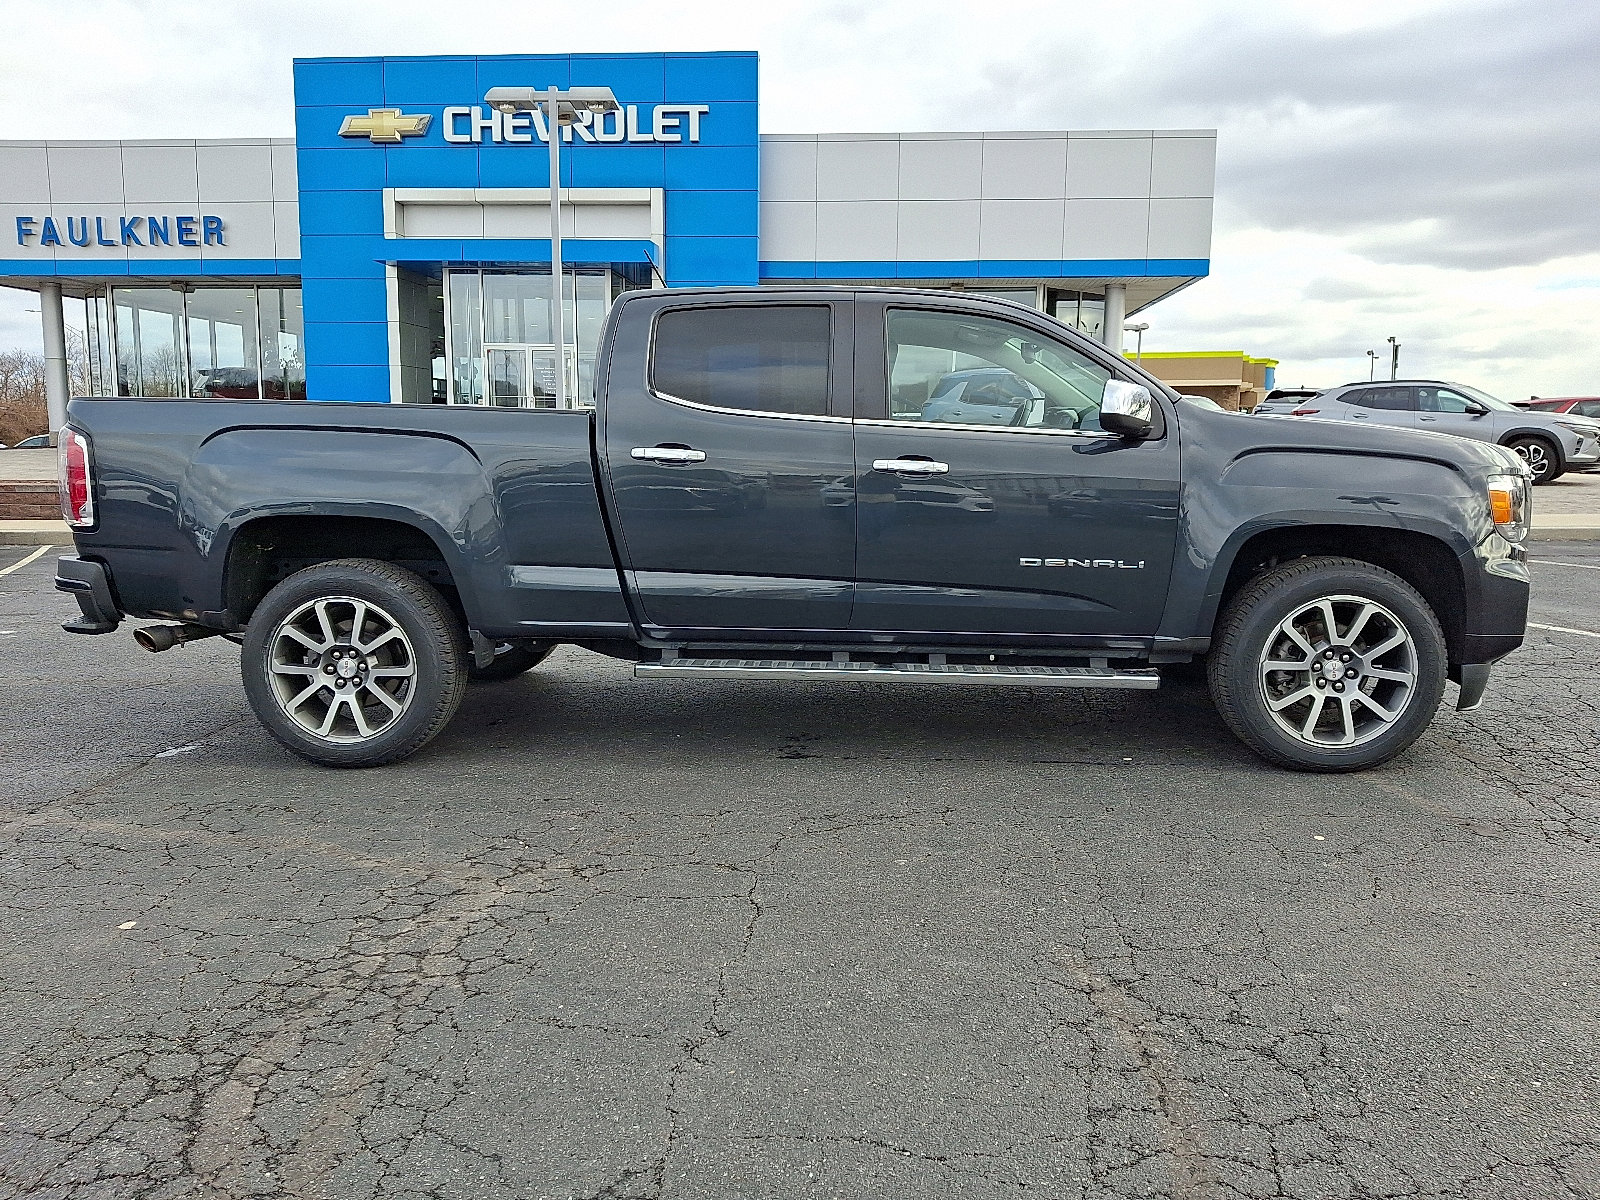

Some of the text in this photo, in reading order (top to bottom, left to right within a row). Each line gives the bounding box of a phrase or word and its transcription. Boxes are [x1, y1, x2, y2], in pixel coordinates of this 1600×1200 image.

[443, 104, 709, 142] CHEVROLET
[15, 215, 227, 247] FAULKNER
[1019, 557, 1145, 569] DENALI
